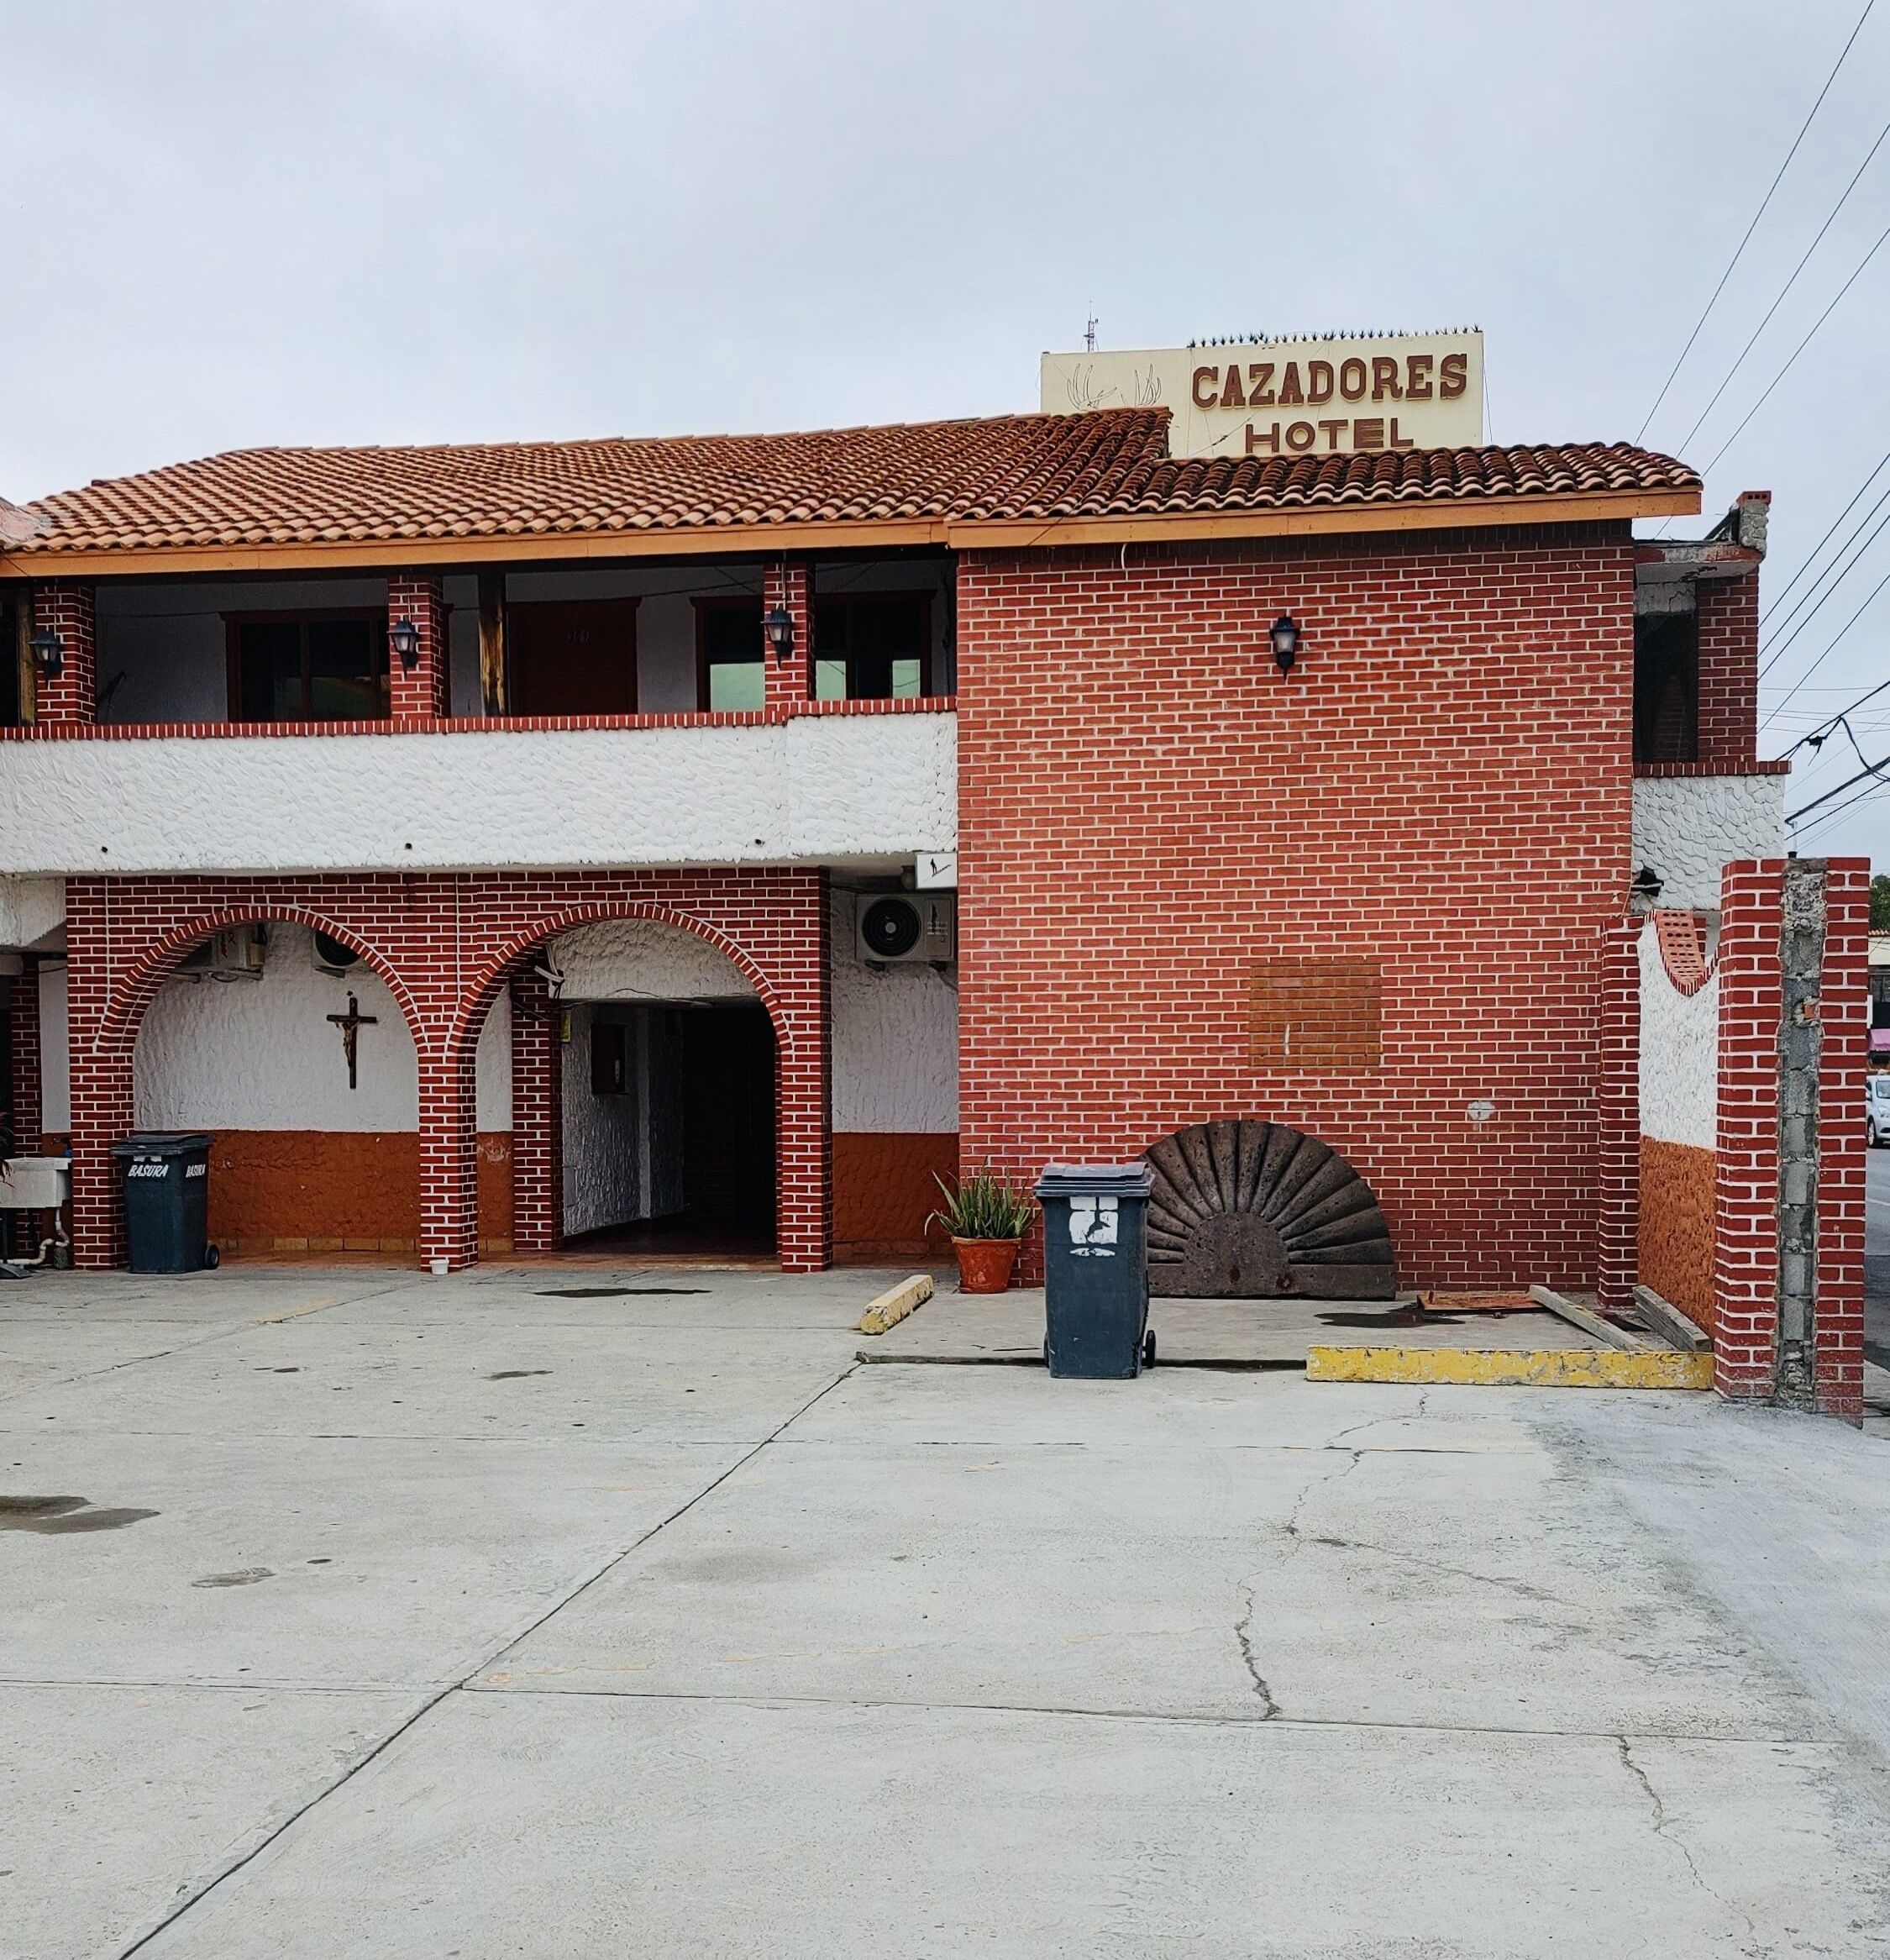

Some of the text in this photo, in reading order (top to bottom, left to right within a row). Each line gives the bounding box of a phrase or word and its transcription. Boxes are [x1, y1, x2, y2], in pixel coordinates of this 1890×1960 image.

[1192, 353, 1467, 409] CAZADORES
[1245, 418, 1414, 454] HOTEL
[128, 1164, 169, 1177] BASURA
[186, 1164, 206, 1178] BASURA
